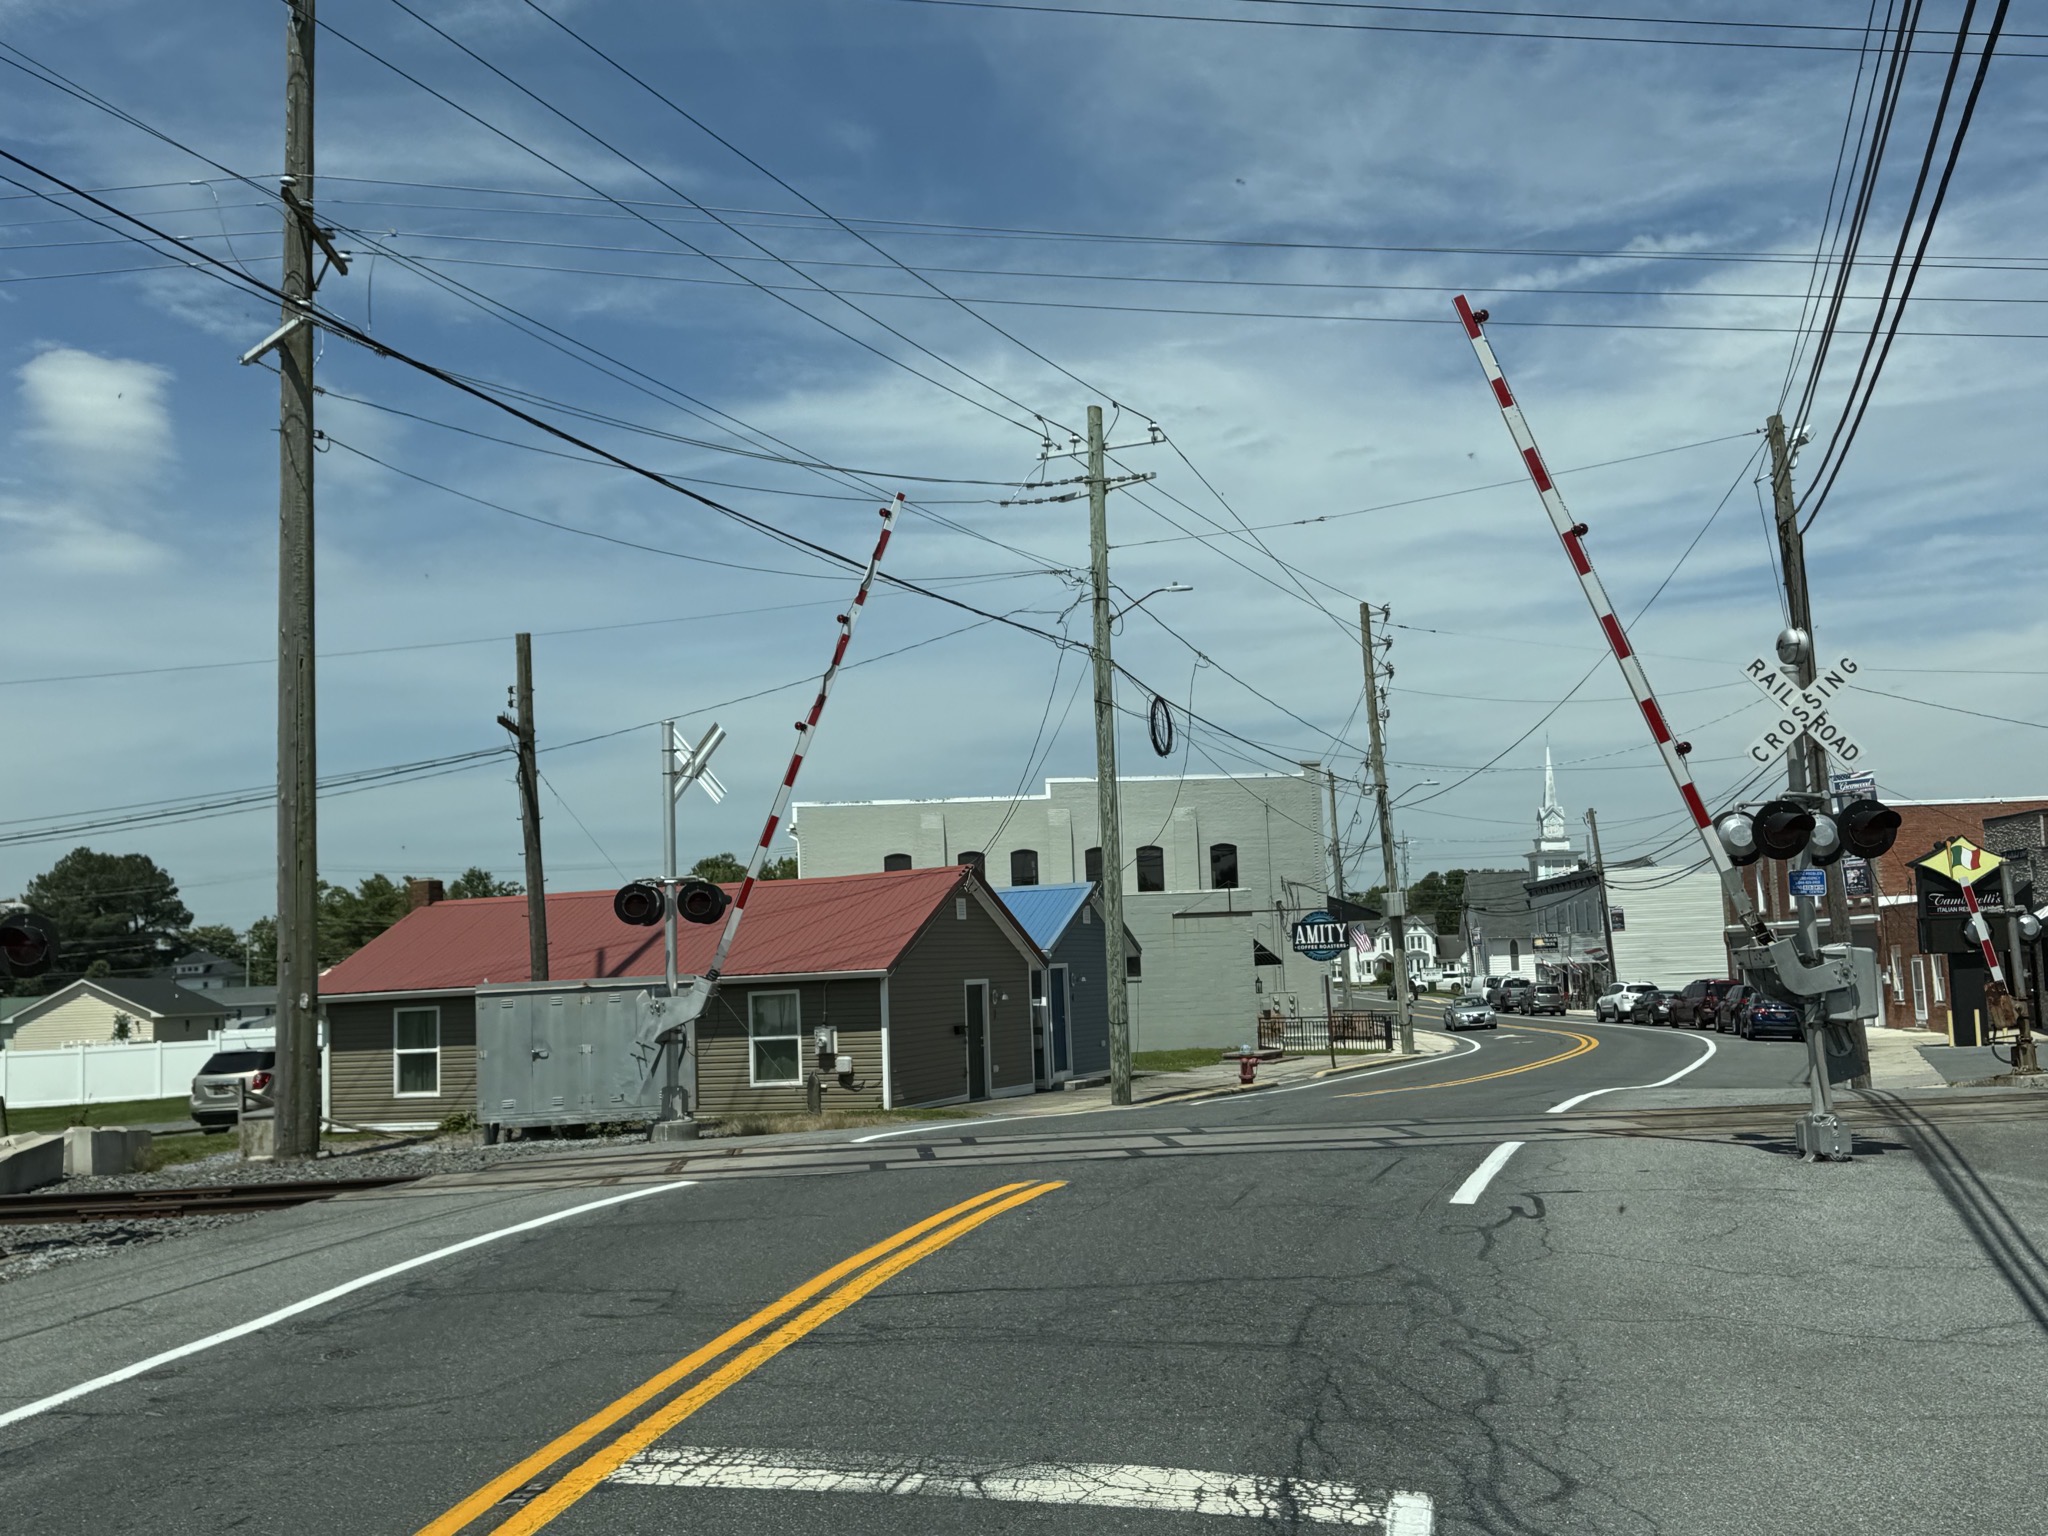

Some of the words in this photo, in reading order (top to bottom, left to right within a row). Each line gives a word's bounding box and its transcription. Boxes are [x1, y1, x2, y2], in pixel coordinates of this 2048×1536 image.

[1752, 658, 1858, 762] CROSSING
[1928, 892, 2002, 906] Tambrelli's
[1295, 923, 1347, 944] AMITY
